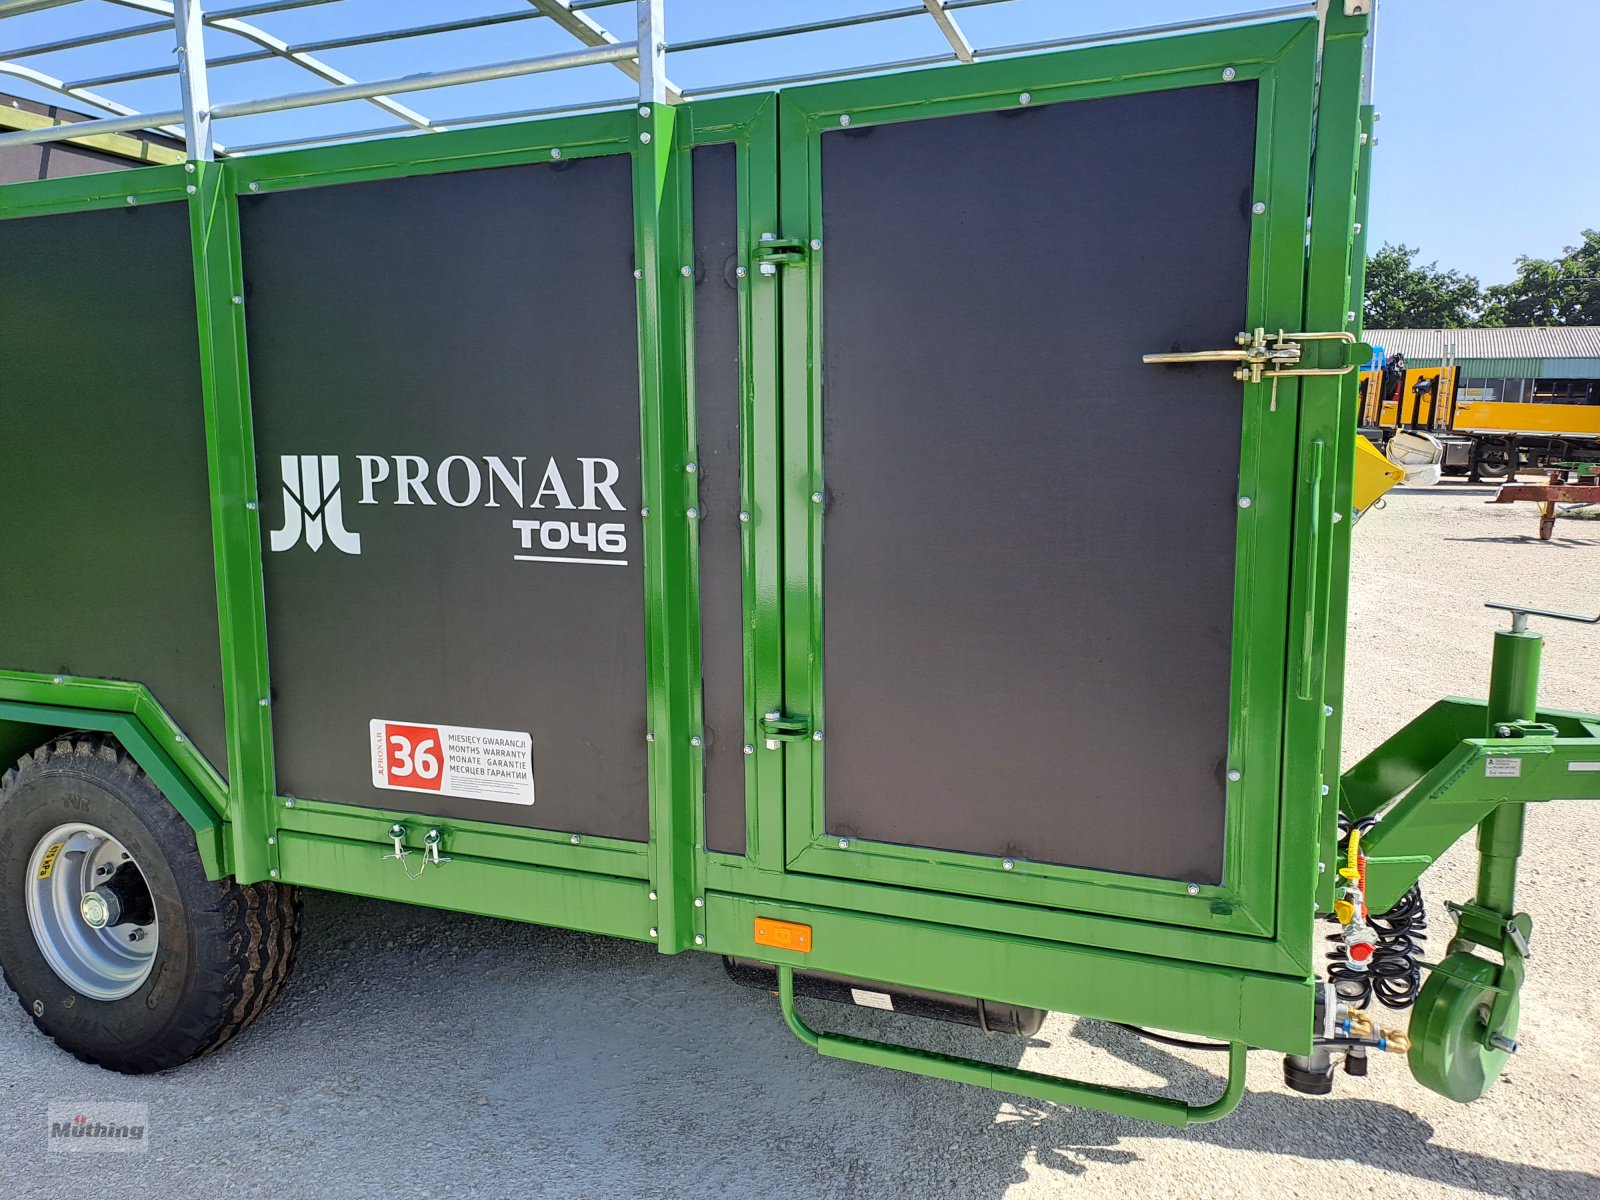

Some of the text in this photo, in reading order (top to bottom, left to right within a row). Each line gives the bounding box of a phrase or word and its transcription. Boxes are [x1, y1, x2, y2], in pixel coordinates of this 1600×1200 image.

[355, 454, 627, 512] PRONAR
[448, 733, 526, 748] MIESIĘCY GWARANCJI
[376, 731, 385, 768] PRONAR
[448, 744, 527, 759] MONTHS WARRANTY
[389, 735, 439, 780] 36
[449, 755, 527, 770] MONATE GARANTIE
[449, 765, 527, 780] МЕСЯЦЕВ ГАРАНТИИ
